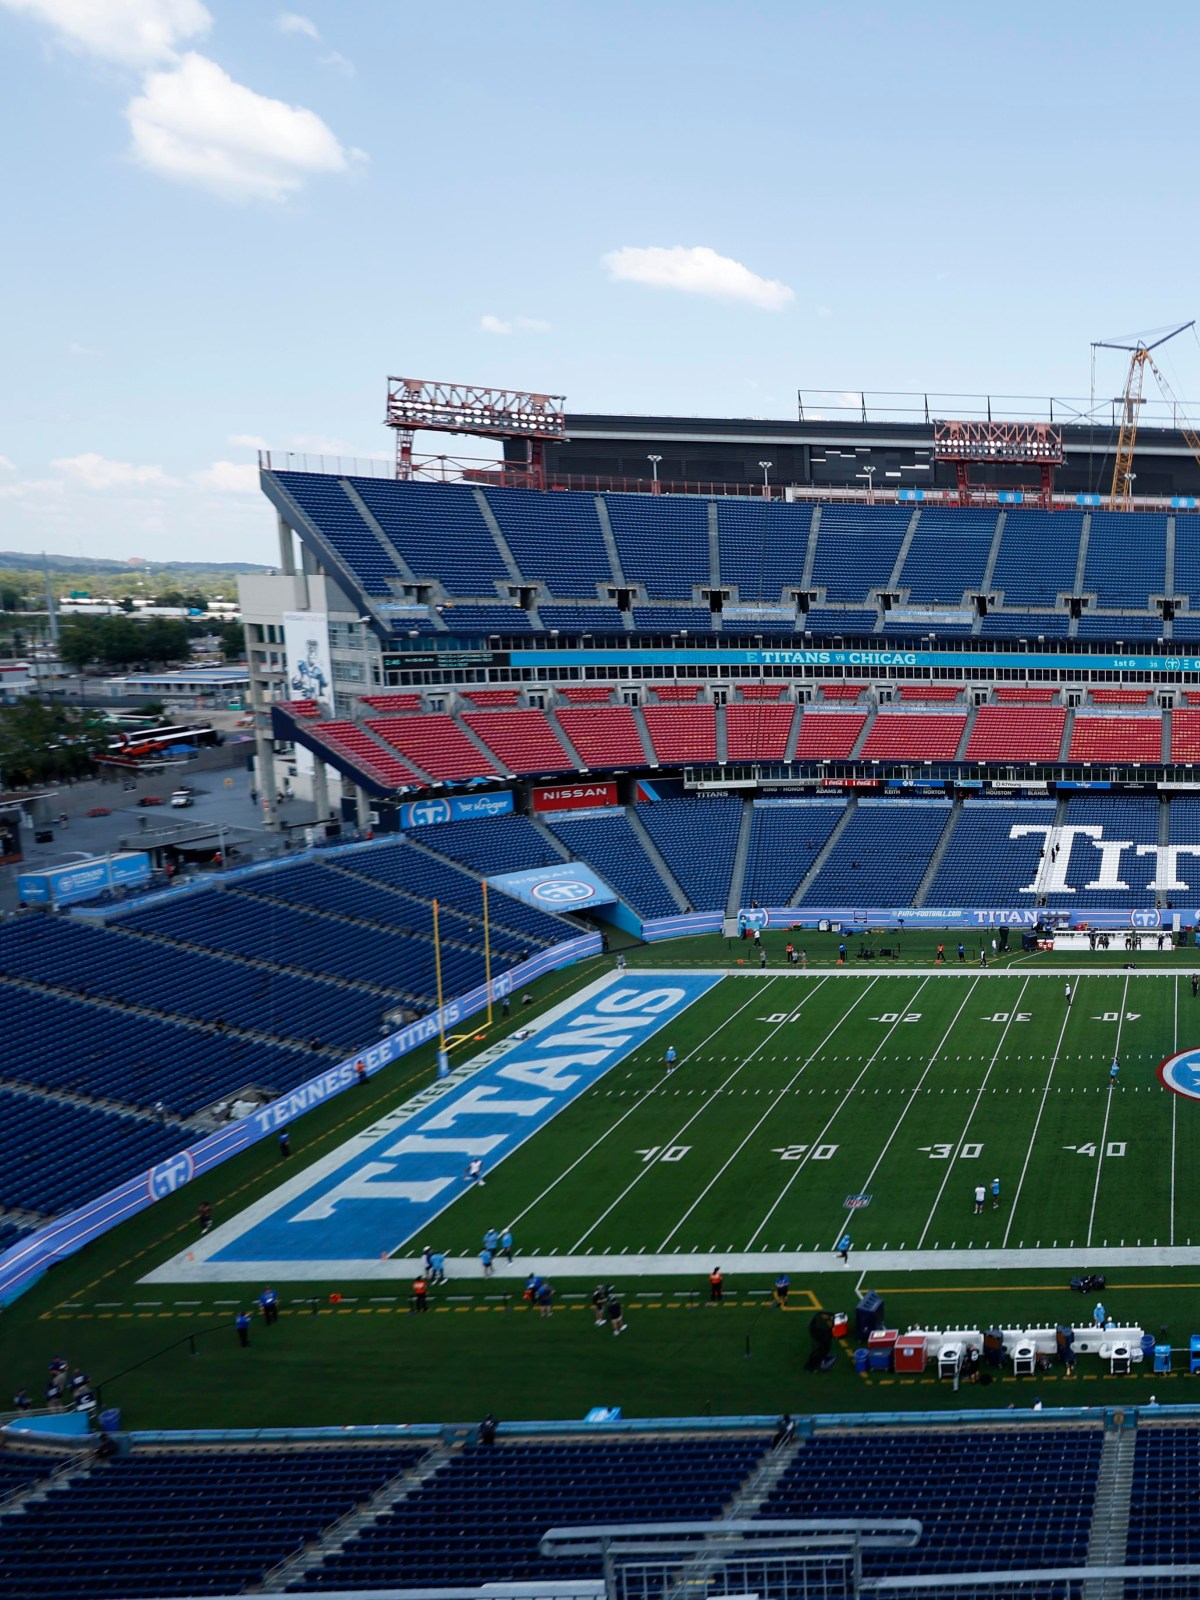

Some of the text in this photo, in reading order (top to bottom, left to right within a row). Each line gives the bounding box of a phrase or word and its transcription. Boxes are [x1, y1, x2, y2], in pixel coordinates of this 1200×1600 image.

[762, 652, 830, 663] TITANS
[543, 788, 607, 800] NISSAN
[696, 790, 728, 798] TITANS
[974, 910, 1038, 924] TITAN
[394, 1004, 462, 1054] TITANS
[289, 987, 686, 1222] TITANS
[358, 1126, 384, 1139] IT
[386, 1082, 454, 1120] TAKES
[452, 1062, 494, 1078] ALL
[641, 1146, 693, 1162] 10
[780, 1144, 839, 1160] 20
[928, 1143, 984, 1159] 30
[1076, 1142, 1128, 1158] 40
